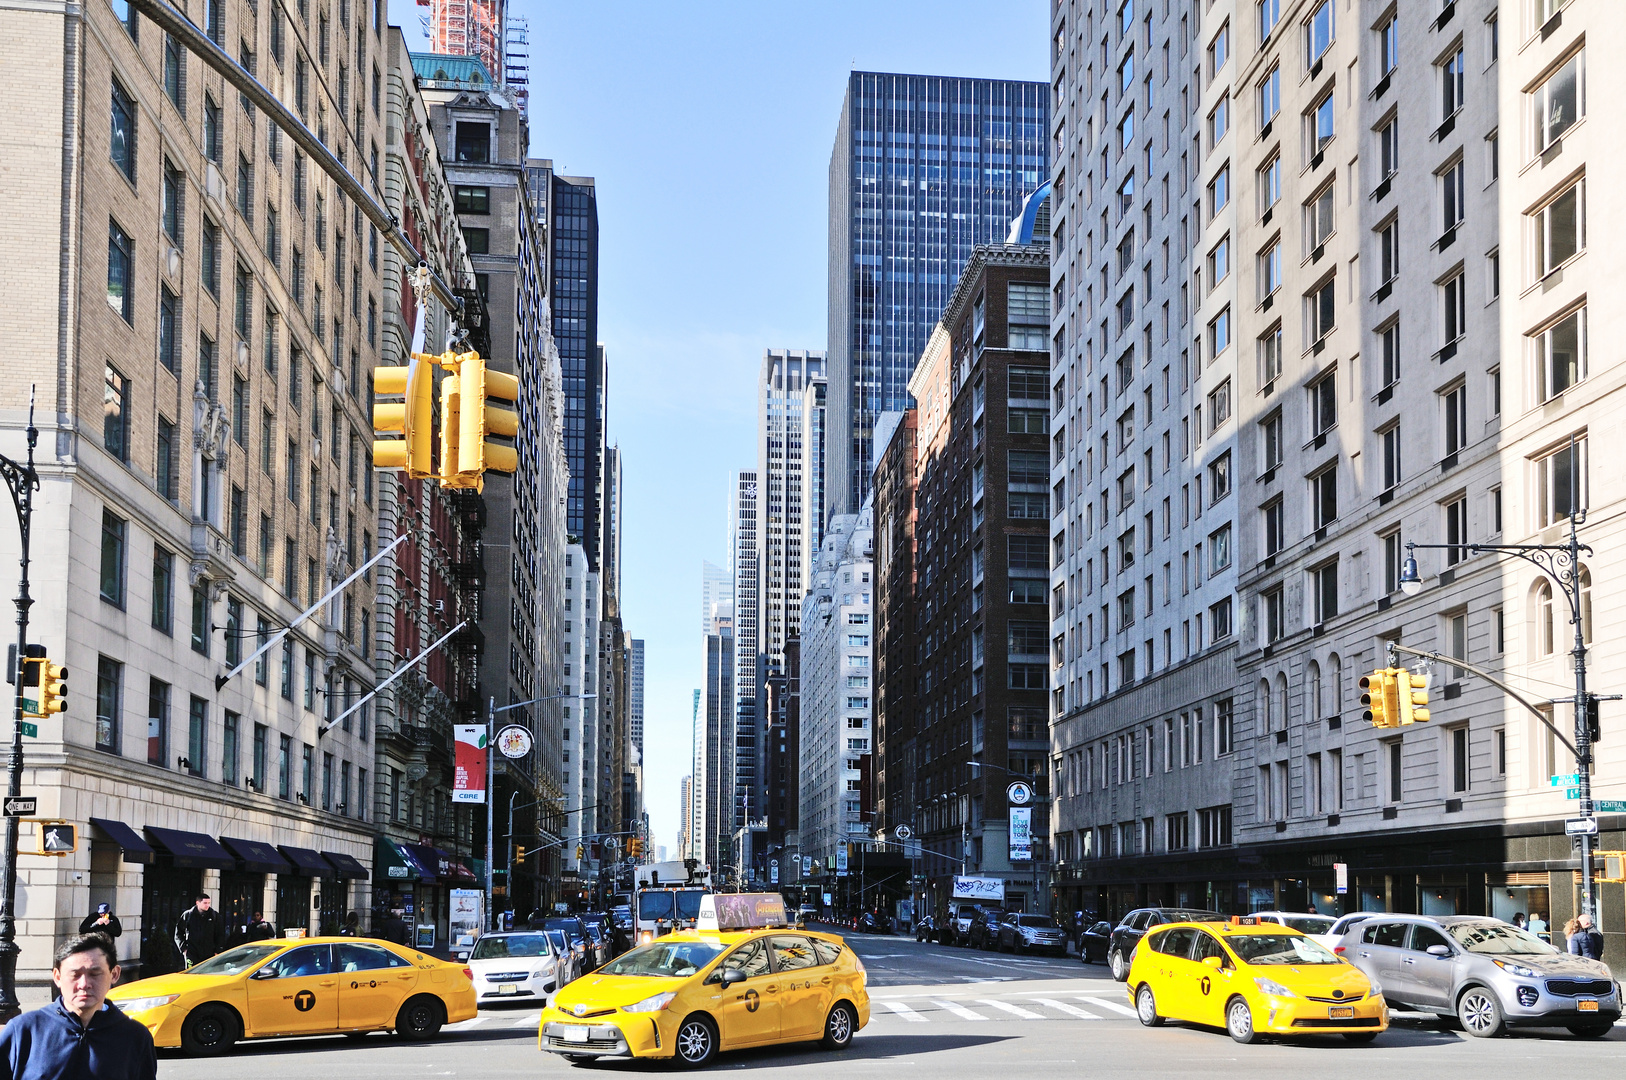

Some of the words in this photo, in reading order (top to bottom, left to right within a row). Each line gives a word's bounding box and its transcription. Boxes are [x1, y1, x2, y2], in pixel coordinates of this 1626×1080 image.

[25, 724, 29, 735] 6
[8, 802, 19, 811] ONE
[22, 802, 33, 810] WAY
